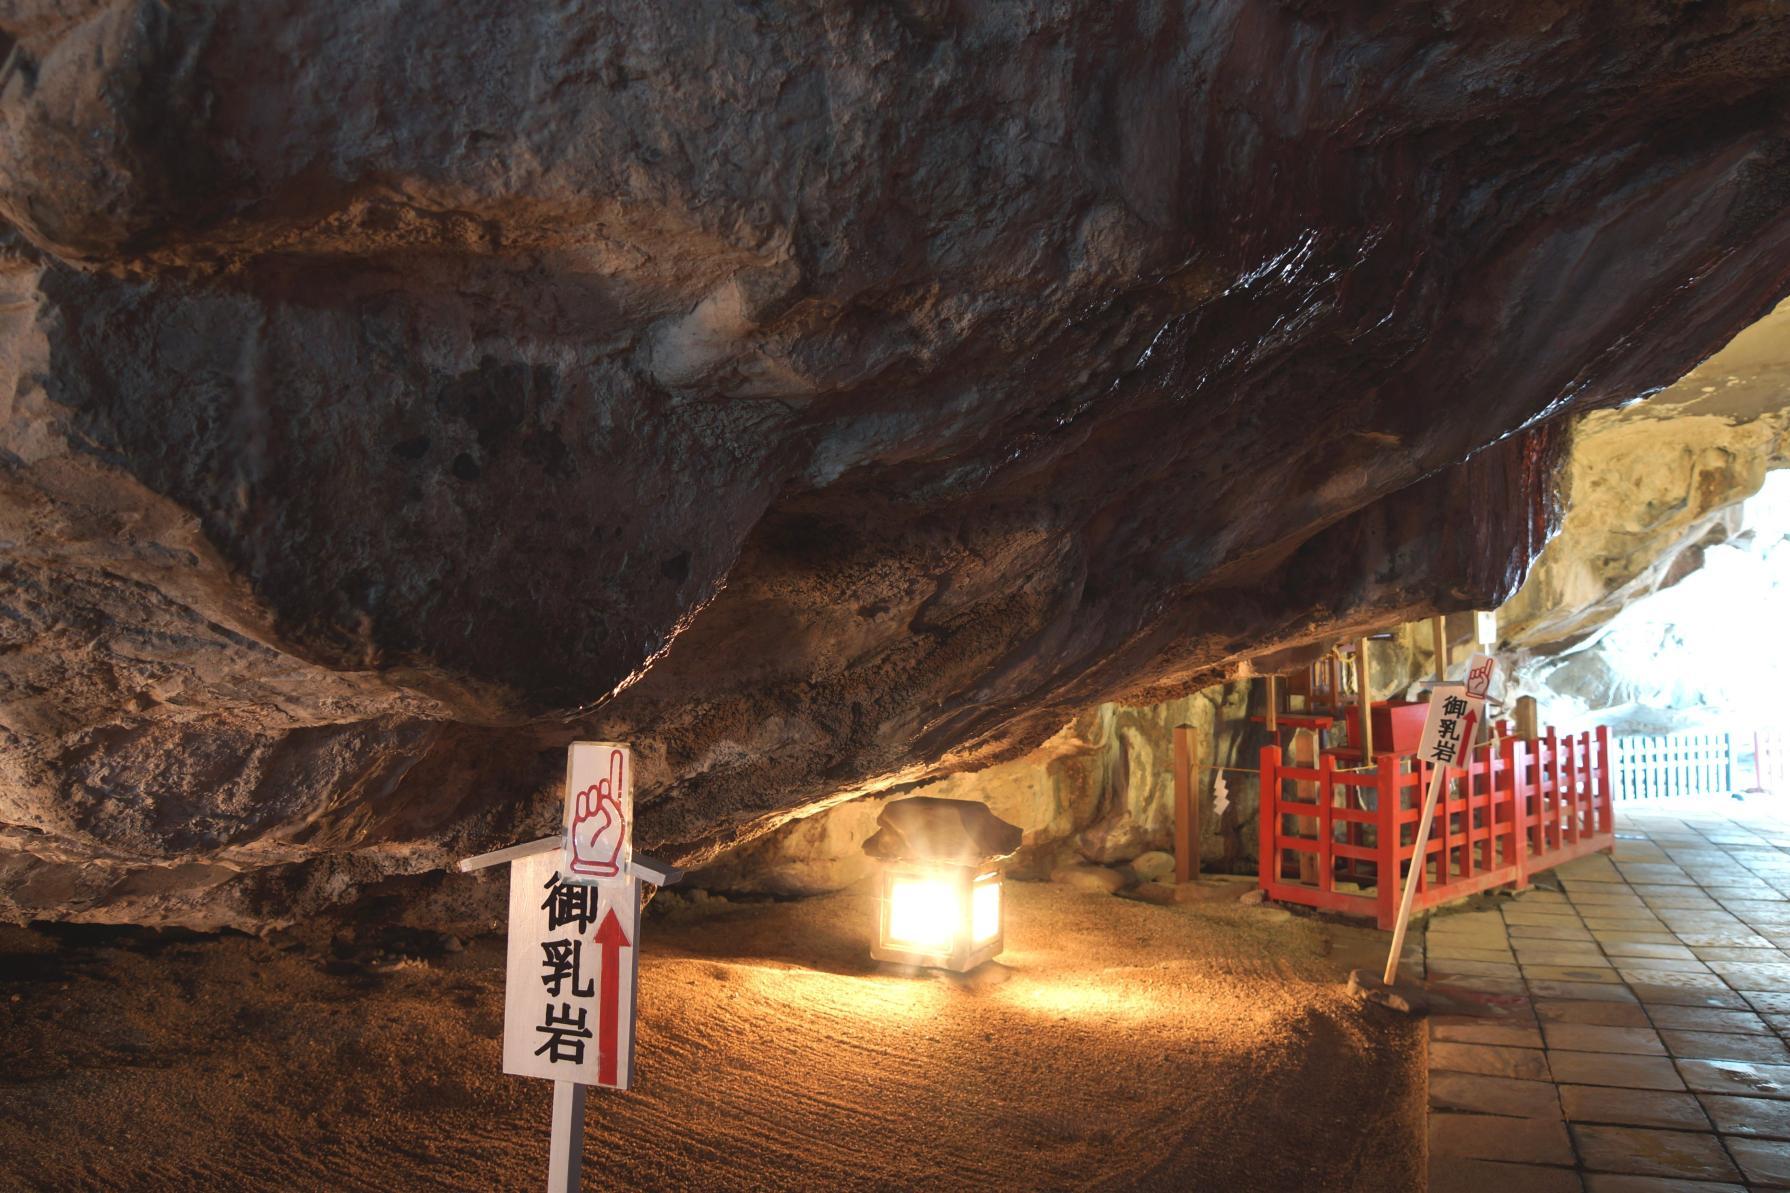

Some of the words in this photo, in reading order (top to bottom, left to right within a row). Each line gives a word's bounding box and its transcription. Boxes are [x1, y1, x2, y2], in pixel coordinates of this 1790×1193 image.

[1431, 695, 1467, 763] 御乳岩
[534, 870, 599, 1065] 御乳岩
